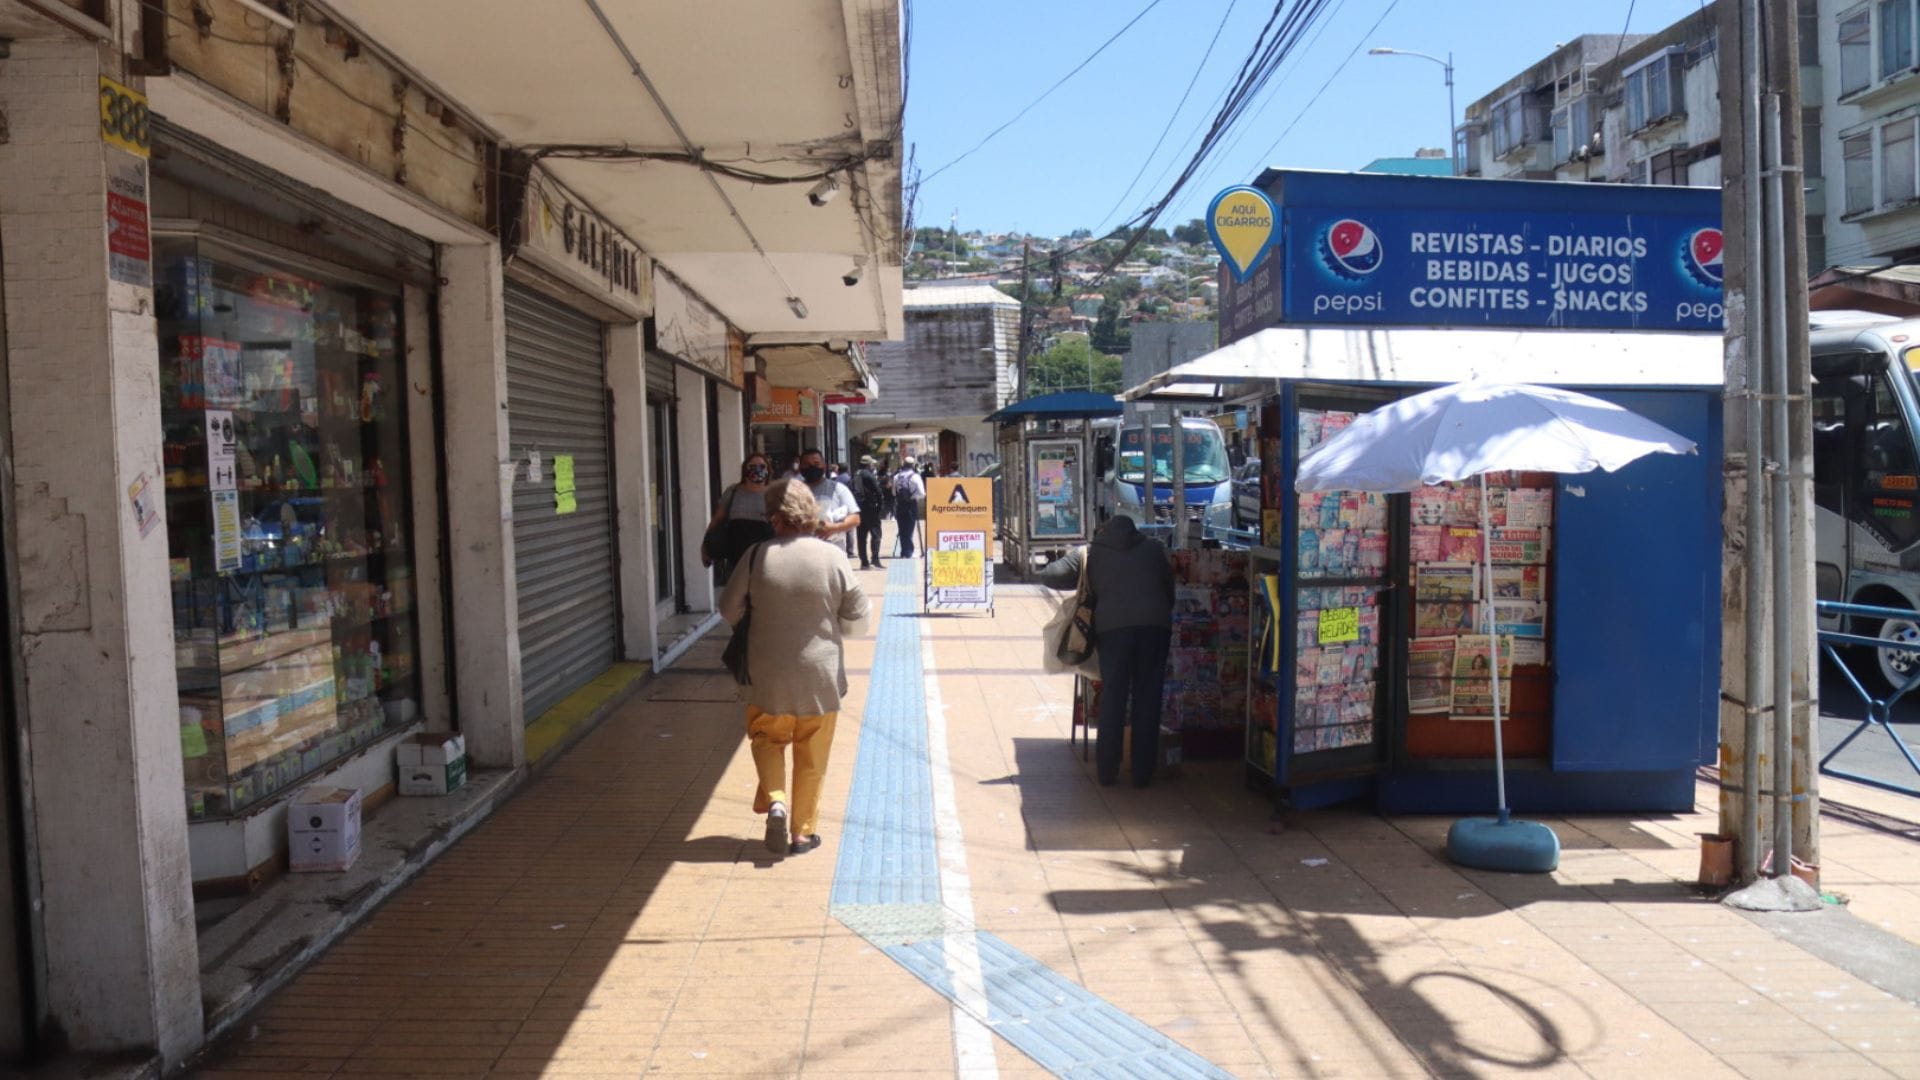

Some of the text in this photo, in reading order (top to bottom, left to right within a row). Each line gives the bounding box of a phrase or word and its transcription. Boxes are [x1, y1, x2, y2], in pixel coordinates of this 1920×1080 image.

[101, 86, 150, 148] 388
[1216, 216, 1271, 228] CIGARROS
[563, 202, 639, 296] GALERIA
[1411, 232, 1524, 255] REVISTAS
[1548, 235, 1648, 258] DIARIOS
[1427, 260, 1530, 282] BEBIDAS
[1551, 262, 1632, 289] JUGOS
[1313, 291, 1382, 315] pepsi
[1409, 287, 1530, 310] CONFITES
[1554, 290, 1648, 312] SNACKS
[1676, 302, 1723, 323] pep
[931, 504, 987, 514] Agrochequen
